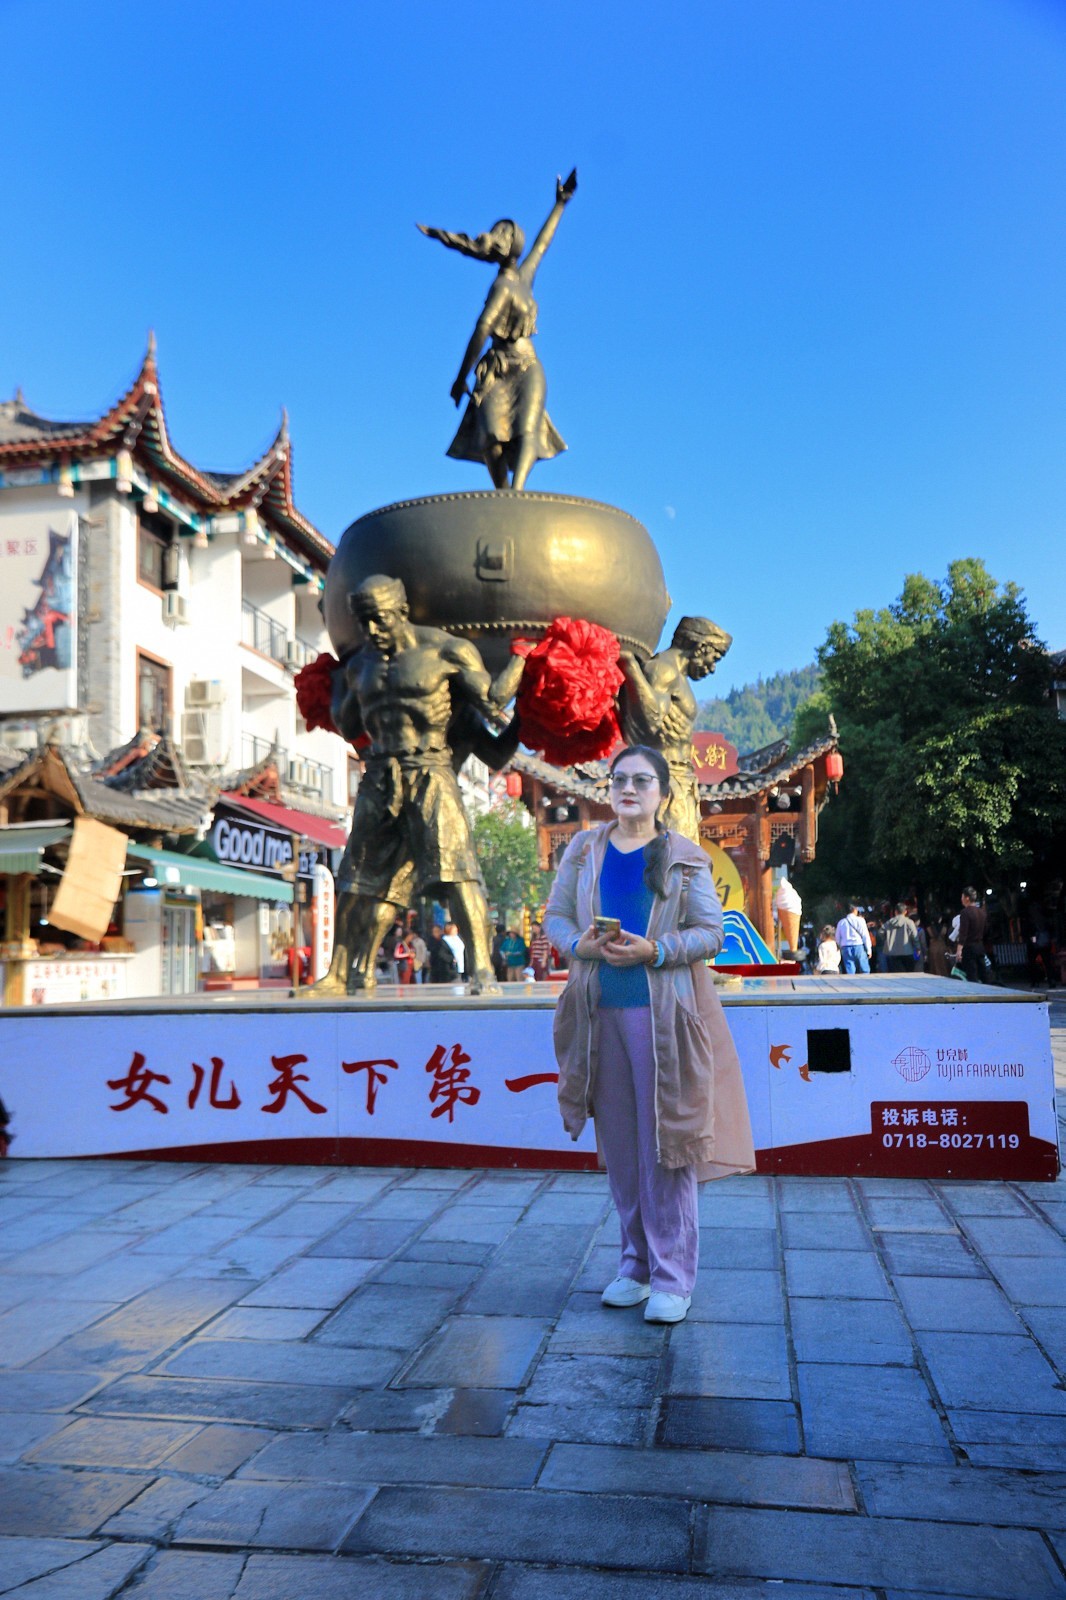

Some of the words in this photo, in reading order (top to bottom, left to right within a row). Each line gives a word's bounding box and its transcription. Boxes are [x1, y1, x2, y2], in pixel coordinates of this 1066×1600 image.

[214, 818, 266, 866] Good
[265, 835, 293, 867] me
[936, 1063, 964, 1081] TUJIA
[966, 1063, 1025, 1078] FAIRYLAND
[106, 1043, 559, 1123] 女儿天下第一
[881, 1108, 967, 1126] 投诉电话：
[882, 1133, 1020, 1149] 0718-8027119
